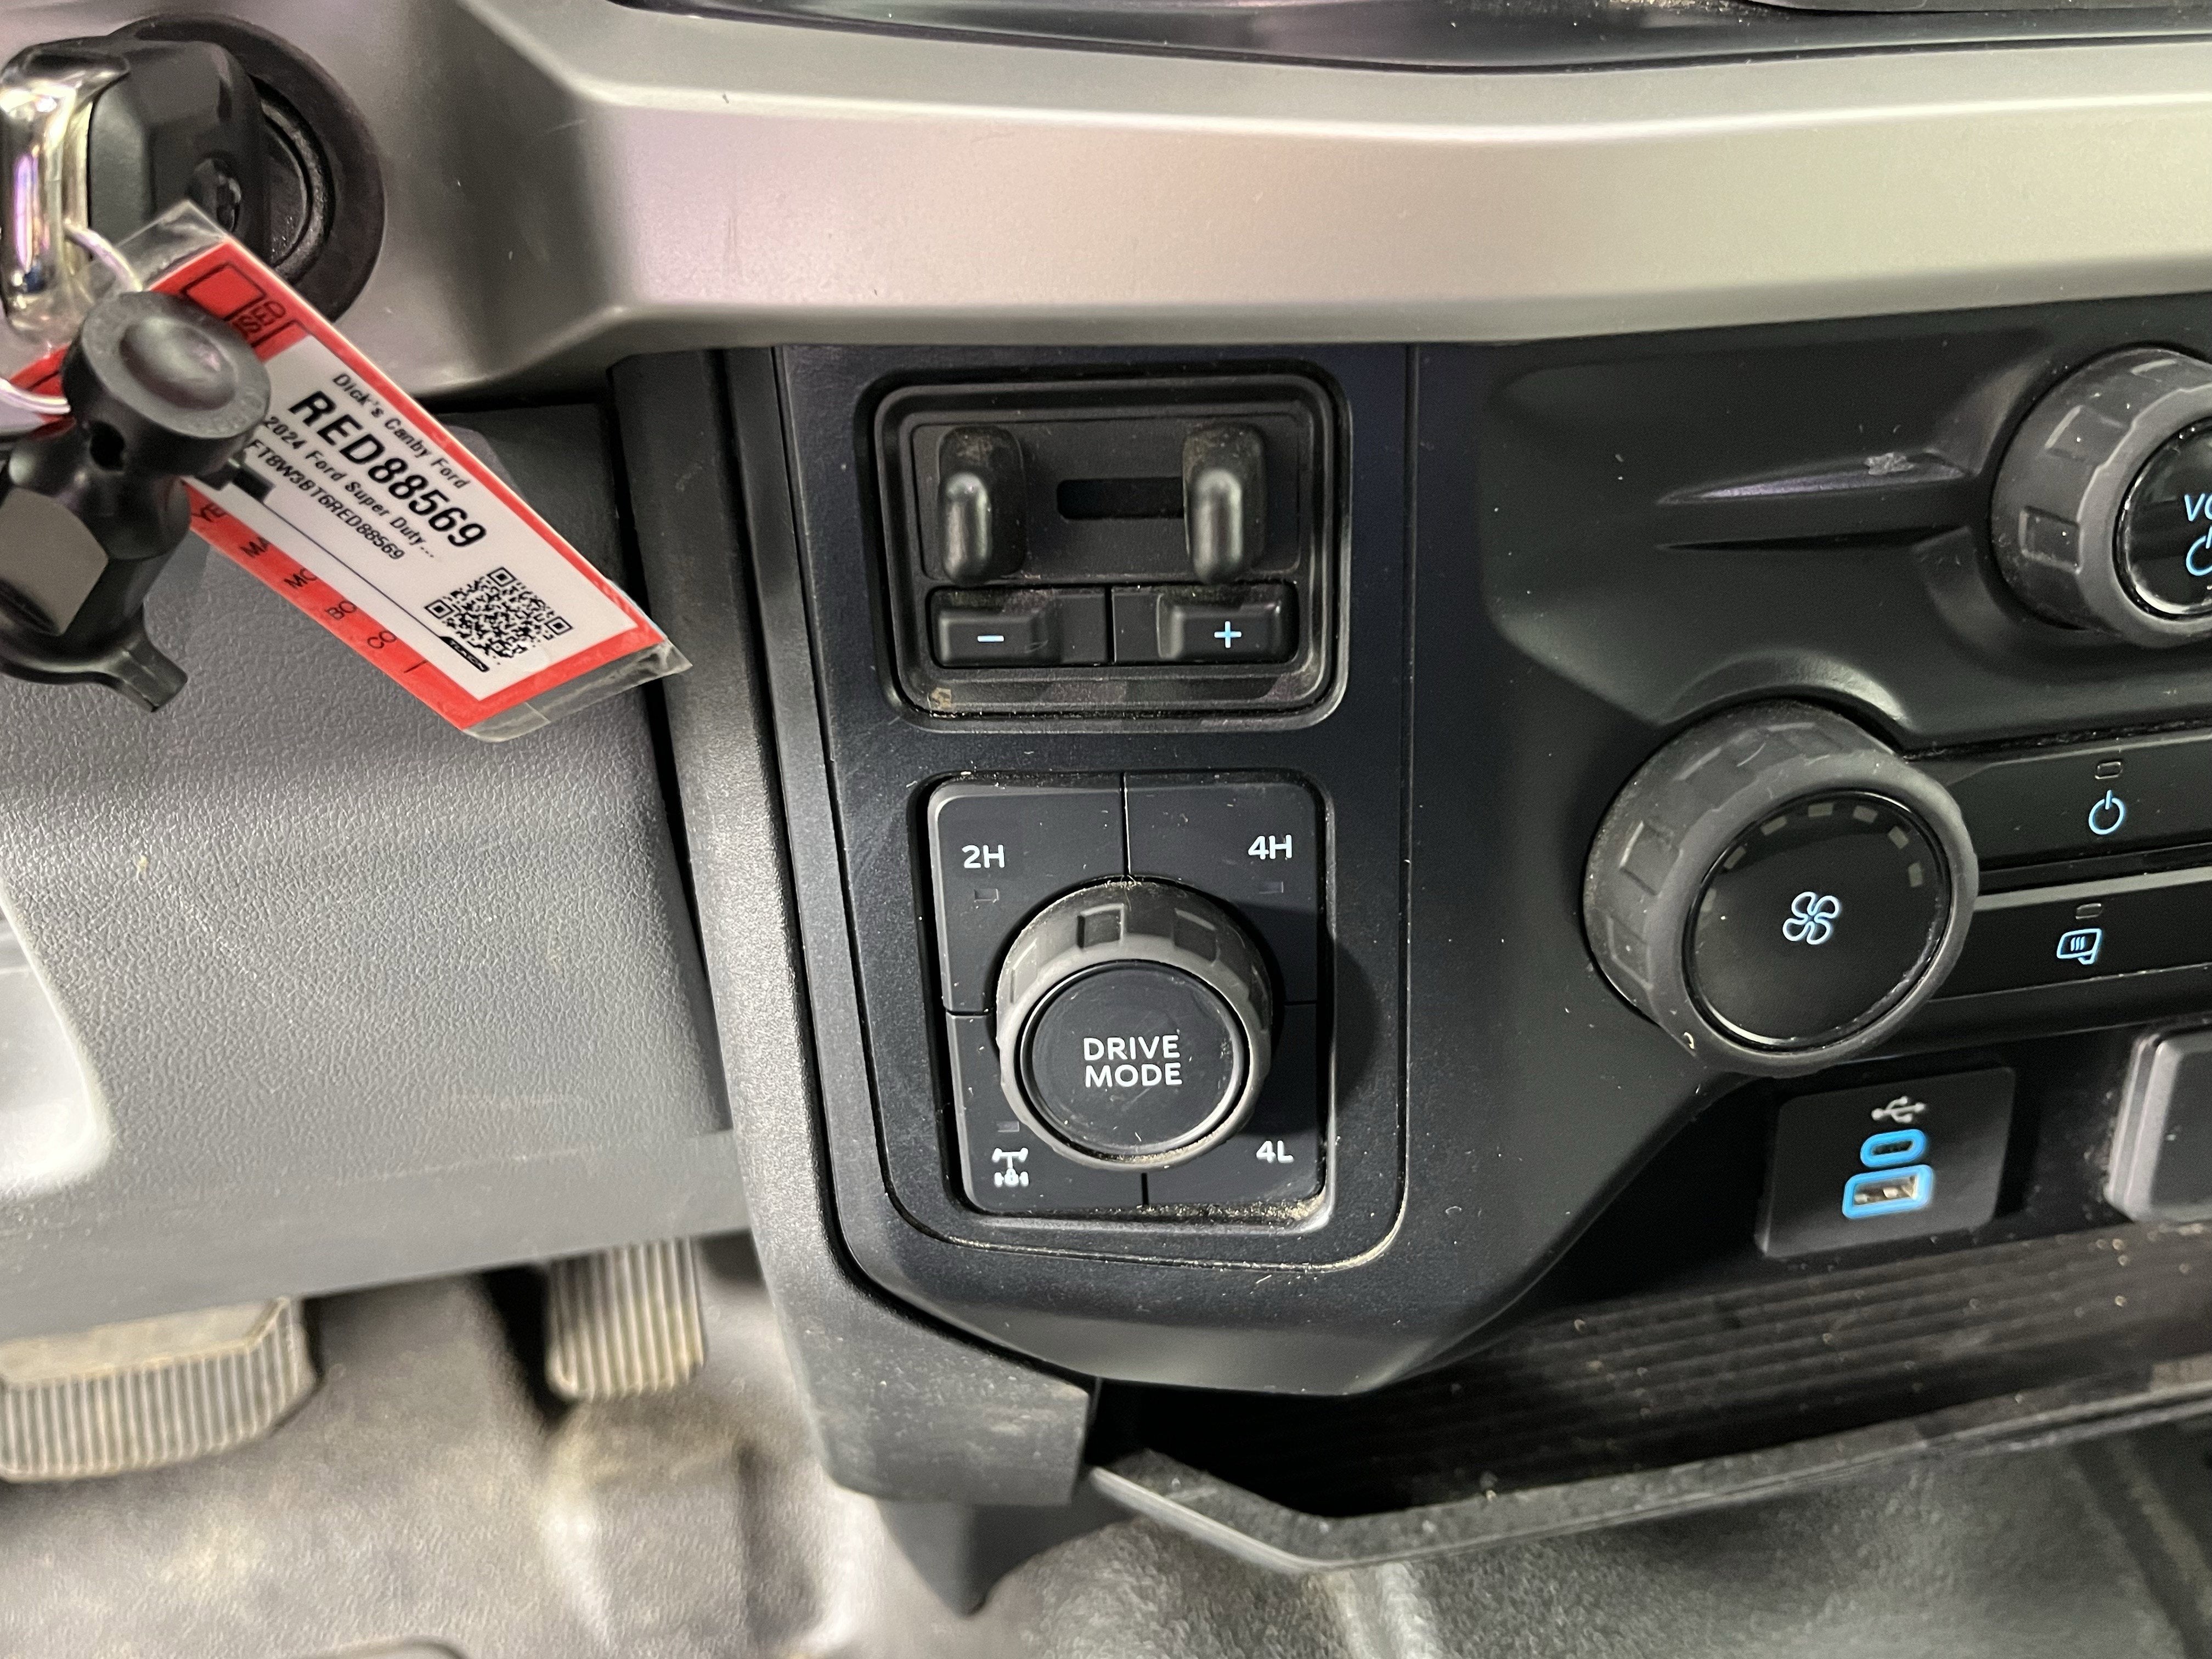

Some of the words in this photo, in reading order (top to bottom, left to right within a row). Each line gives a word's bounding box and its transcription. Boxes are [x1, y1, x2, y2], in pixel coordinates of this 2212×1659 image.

[332, 373, 383, 417] Dick's
[385, 418, 432, 458] Canby
[431, 457, 470, 488] Ford
[264, 416, 308, 449] 2024
[305, 450, 348, 481] Ford
[345, 481, 390, 516] Super
[288, 391, 486, 548] RED88569
[961, 845, 1005, 868] 2H
[1248, 834, 1293, 860] 4H
[1083, 1035, 1181, 1061] DRIVE
[1085, 1062, 1183, 1088] MODE
[1256, 1140, 1295, 1163] 4L
